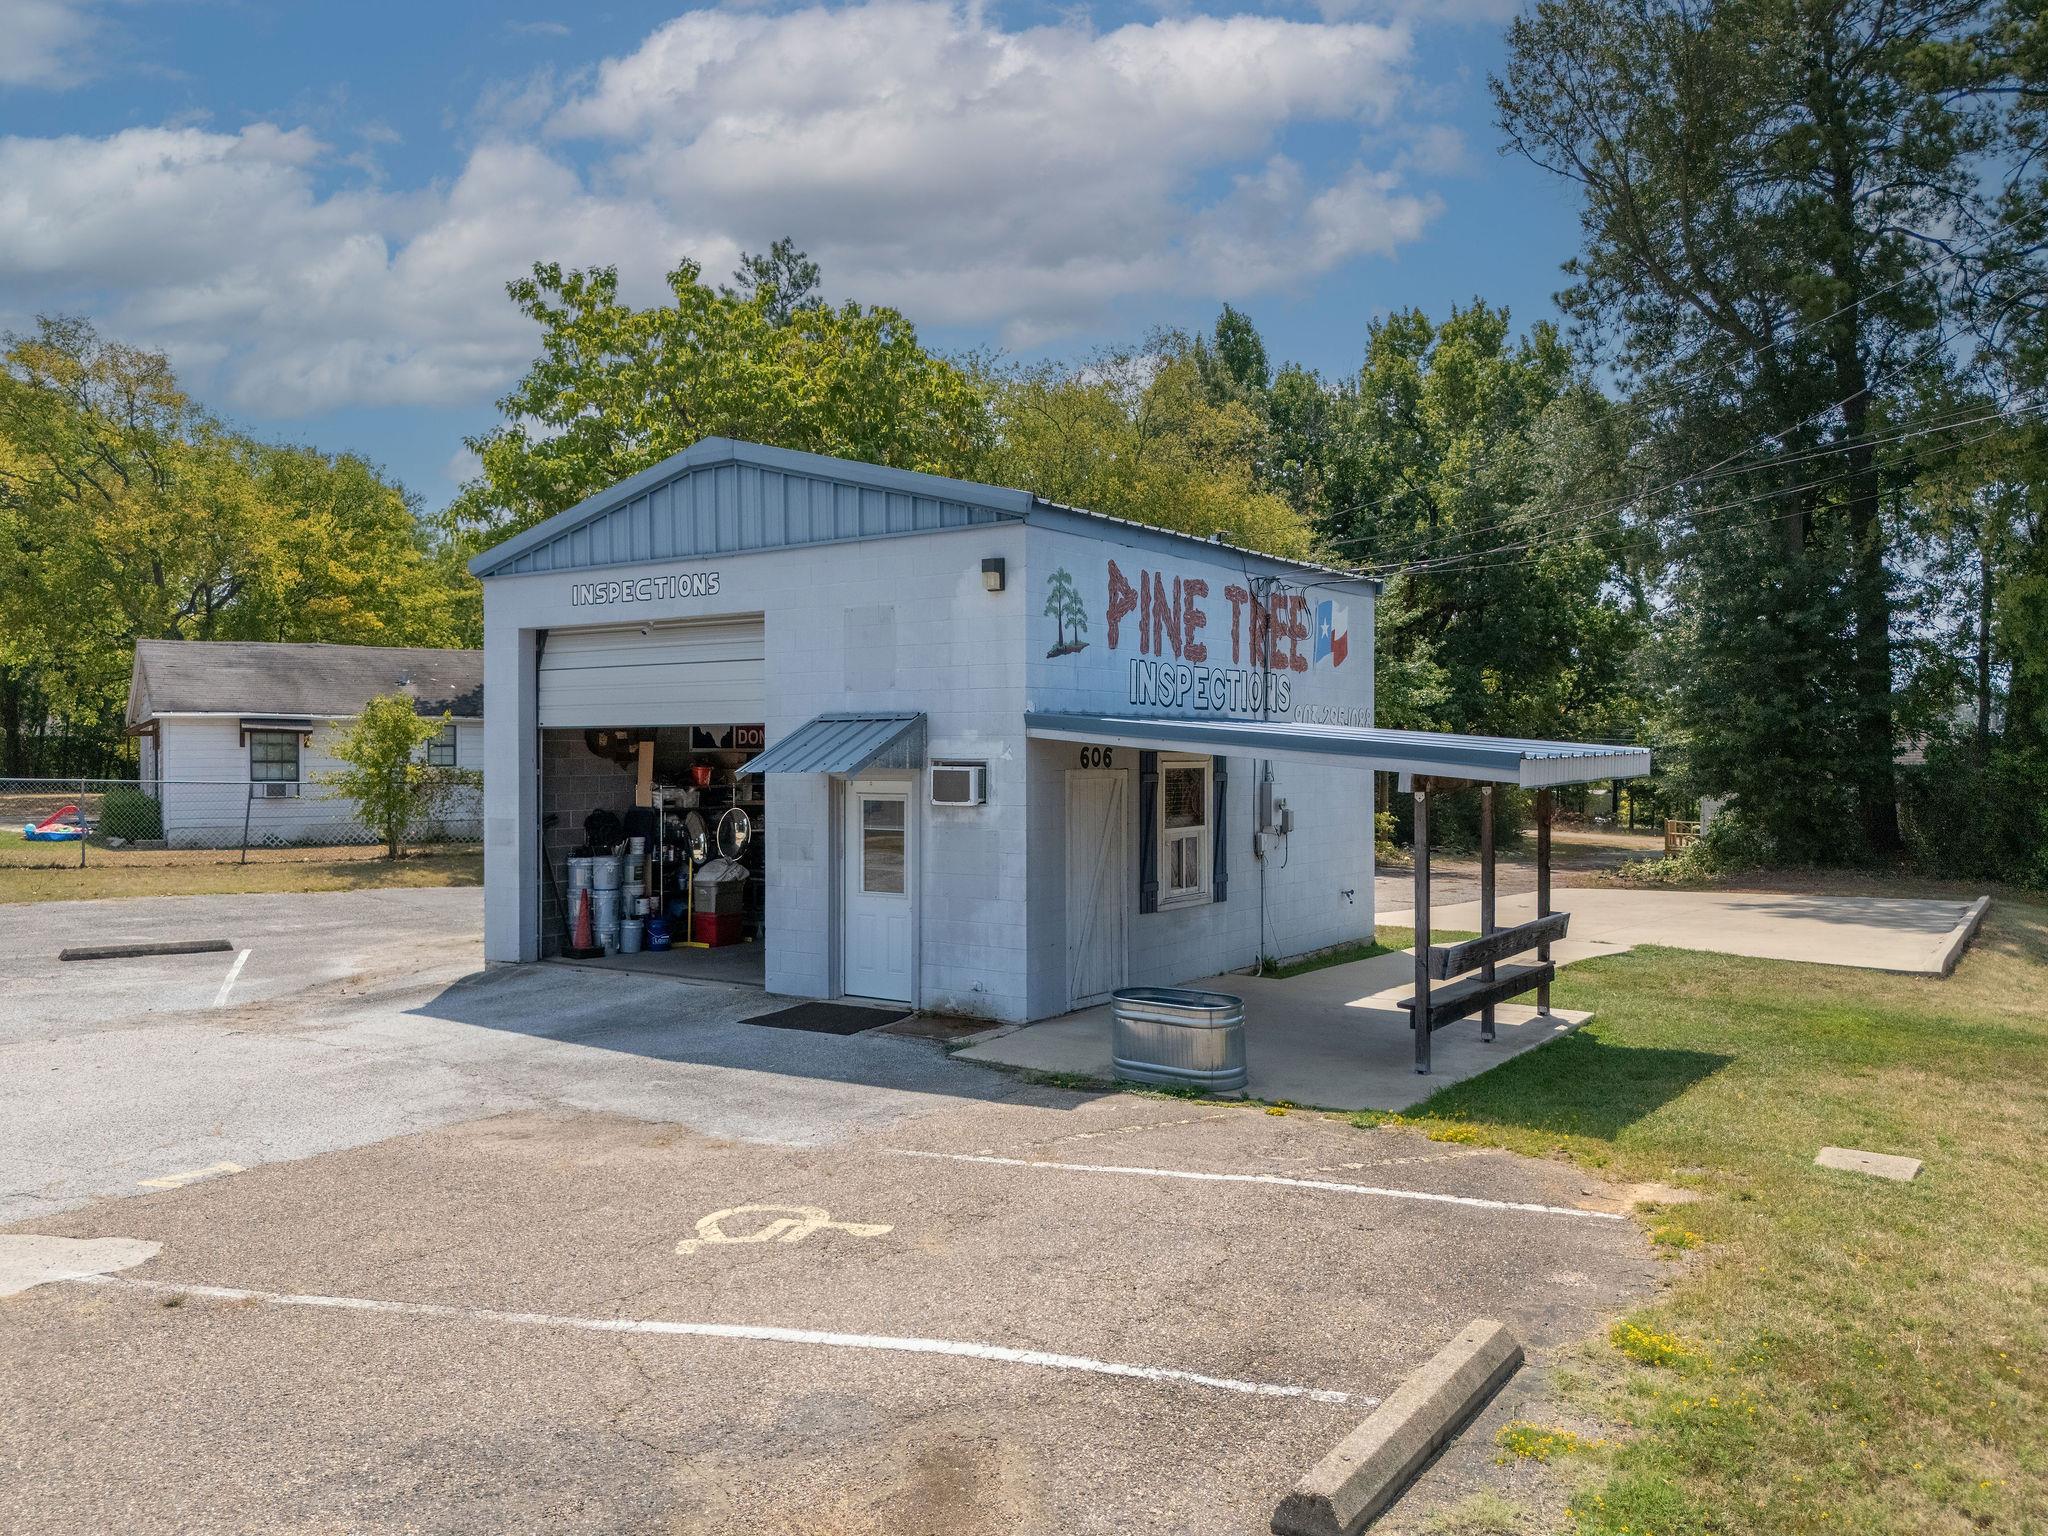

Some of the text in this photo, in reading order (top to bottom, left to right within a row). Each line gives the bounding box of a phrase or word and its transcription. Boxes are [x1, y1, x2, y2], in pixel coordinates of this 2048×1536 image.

[571, 572, 721, 606] INSPECTIONS
[1106, 559, 1308, 672] PINE TREE
[1129, 658, 1291, 713] INSPECTIONS
[1080, 746, 1113, 769] 606
